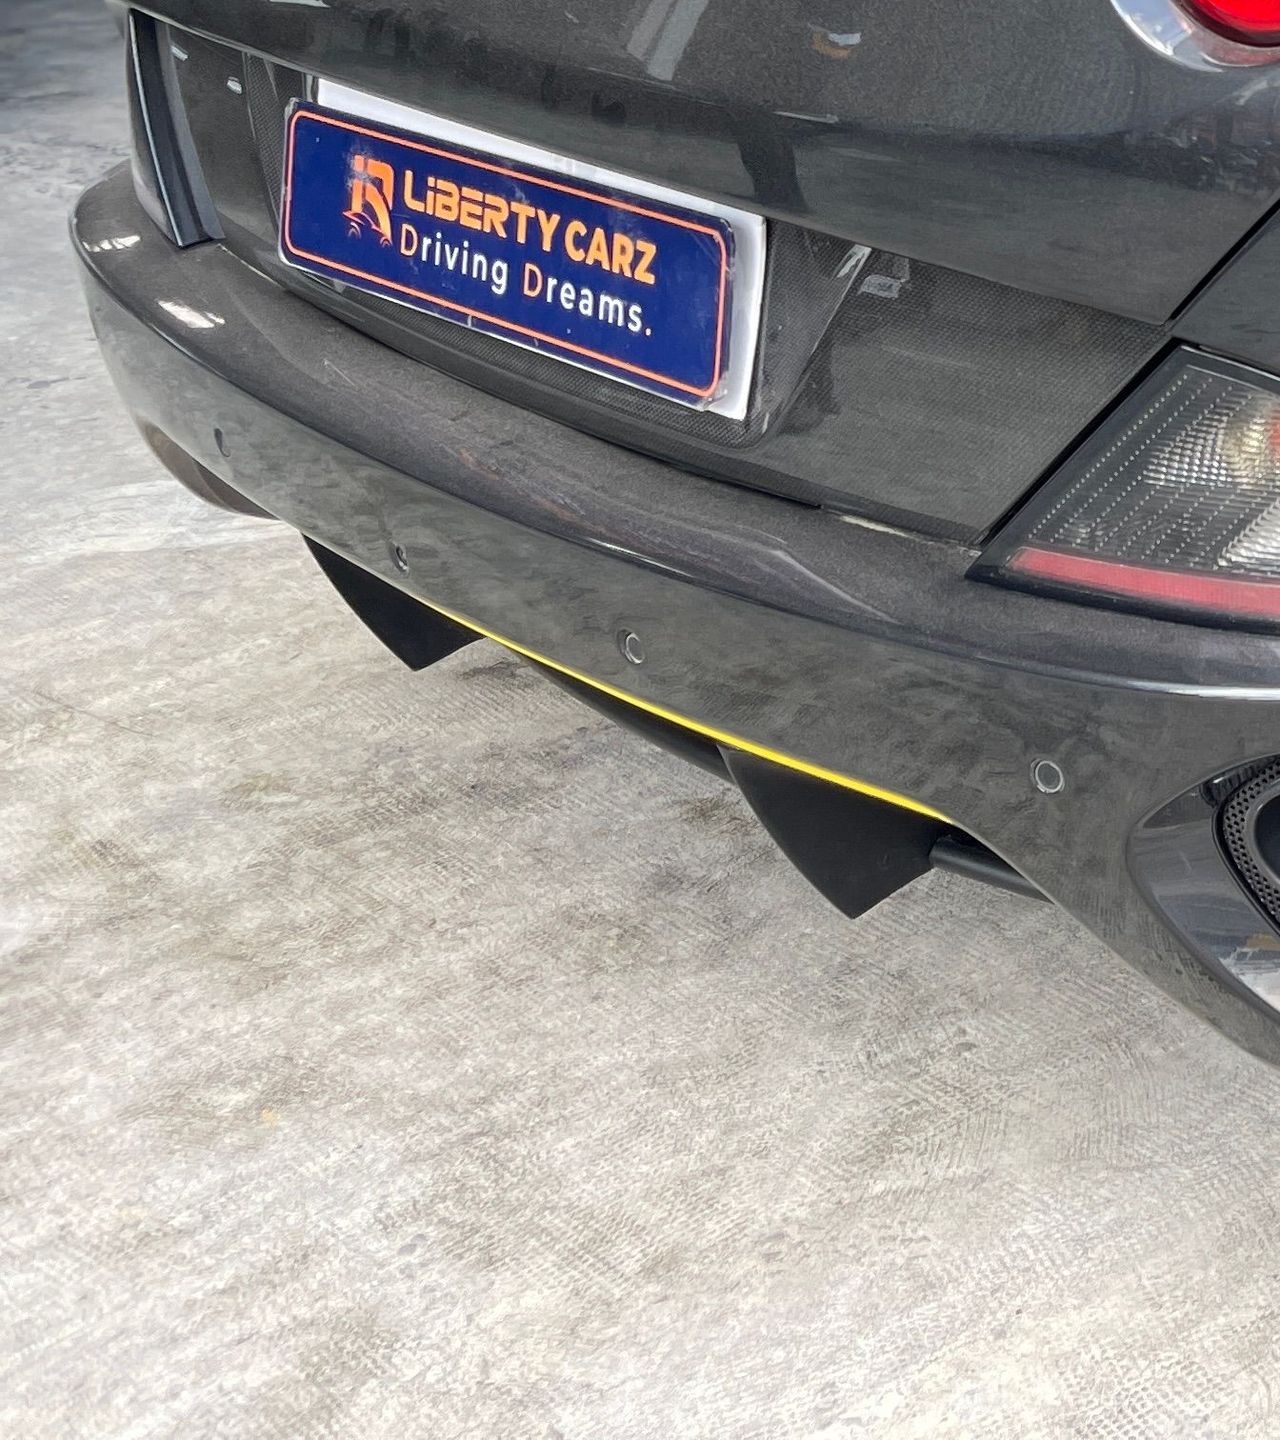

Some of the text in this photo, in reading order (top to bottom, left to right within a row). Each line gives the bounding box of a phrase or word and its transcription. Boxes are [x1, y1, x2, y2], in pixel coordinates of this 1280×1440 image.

[400, 222, 653, 337] Driving Dreams.
[563, 219, 658, 285] CARZ
